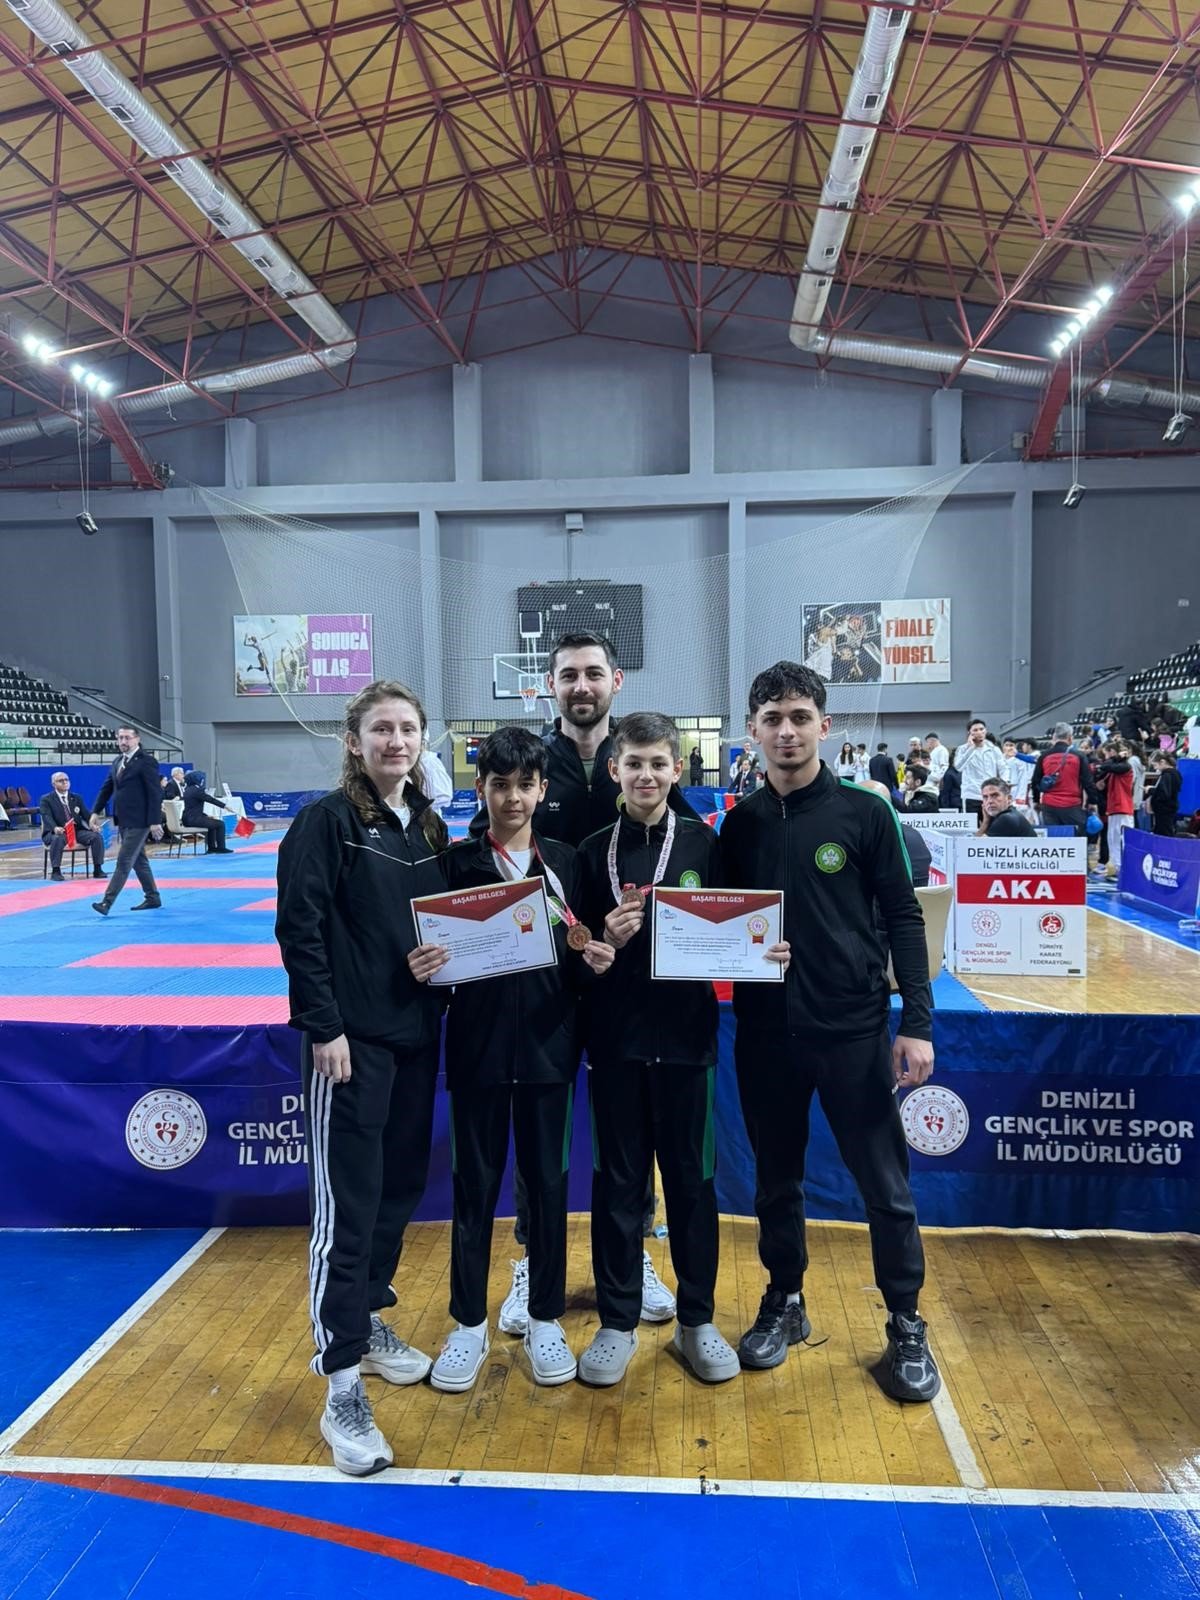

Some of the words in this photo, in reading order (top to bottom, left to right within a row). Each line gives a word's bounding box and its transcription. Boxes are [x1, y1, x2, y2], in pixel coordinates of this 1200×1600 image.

[886, 617, 935, 638] FİNALE
[311, 632, 369, 650] SONUCA
[312, 658, 350, 679] ULAŞ
[932, 820, 969, 828] KARATE
[967, 845, 1018, 858] DENİZLİ
[1021, 847, 1076, 858] KARATE
[983, 860, 992, 869] İL
[994, 860, 1059, 870] TEMSİLCİLİĞİ
[987, 880, 1056, 900] AKA
[1041, 1087, 1136, 1110] DENİZLİ
[228, 1119, 304, 1145] GENÇL
[984, 1114, 1088, 1139] GENÇLİK
[1092, 1119, 1123, 1136] VE
[1128, 1119, 1194, 1139] SPOR
[238, 1141, 258, 1165] İL
[997, 1139, 1017, 1161] İL
[1023, 1140, 1182, 1165] MÜDÜRLÜĞÜ
